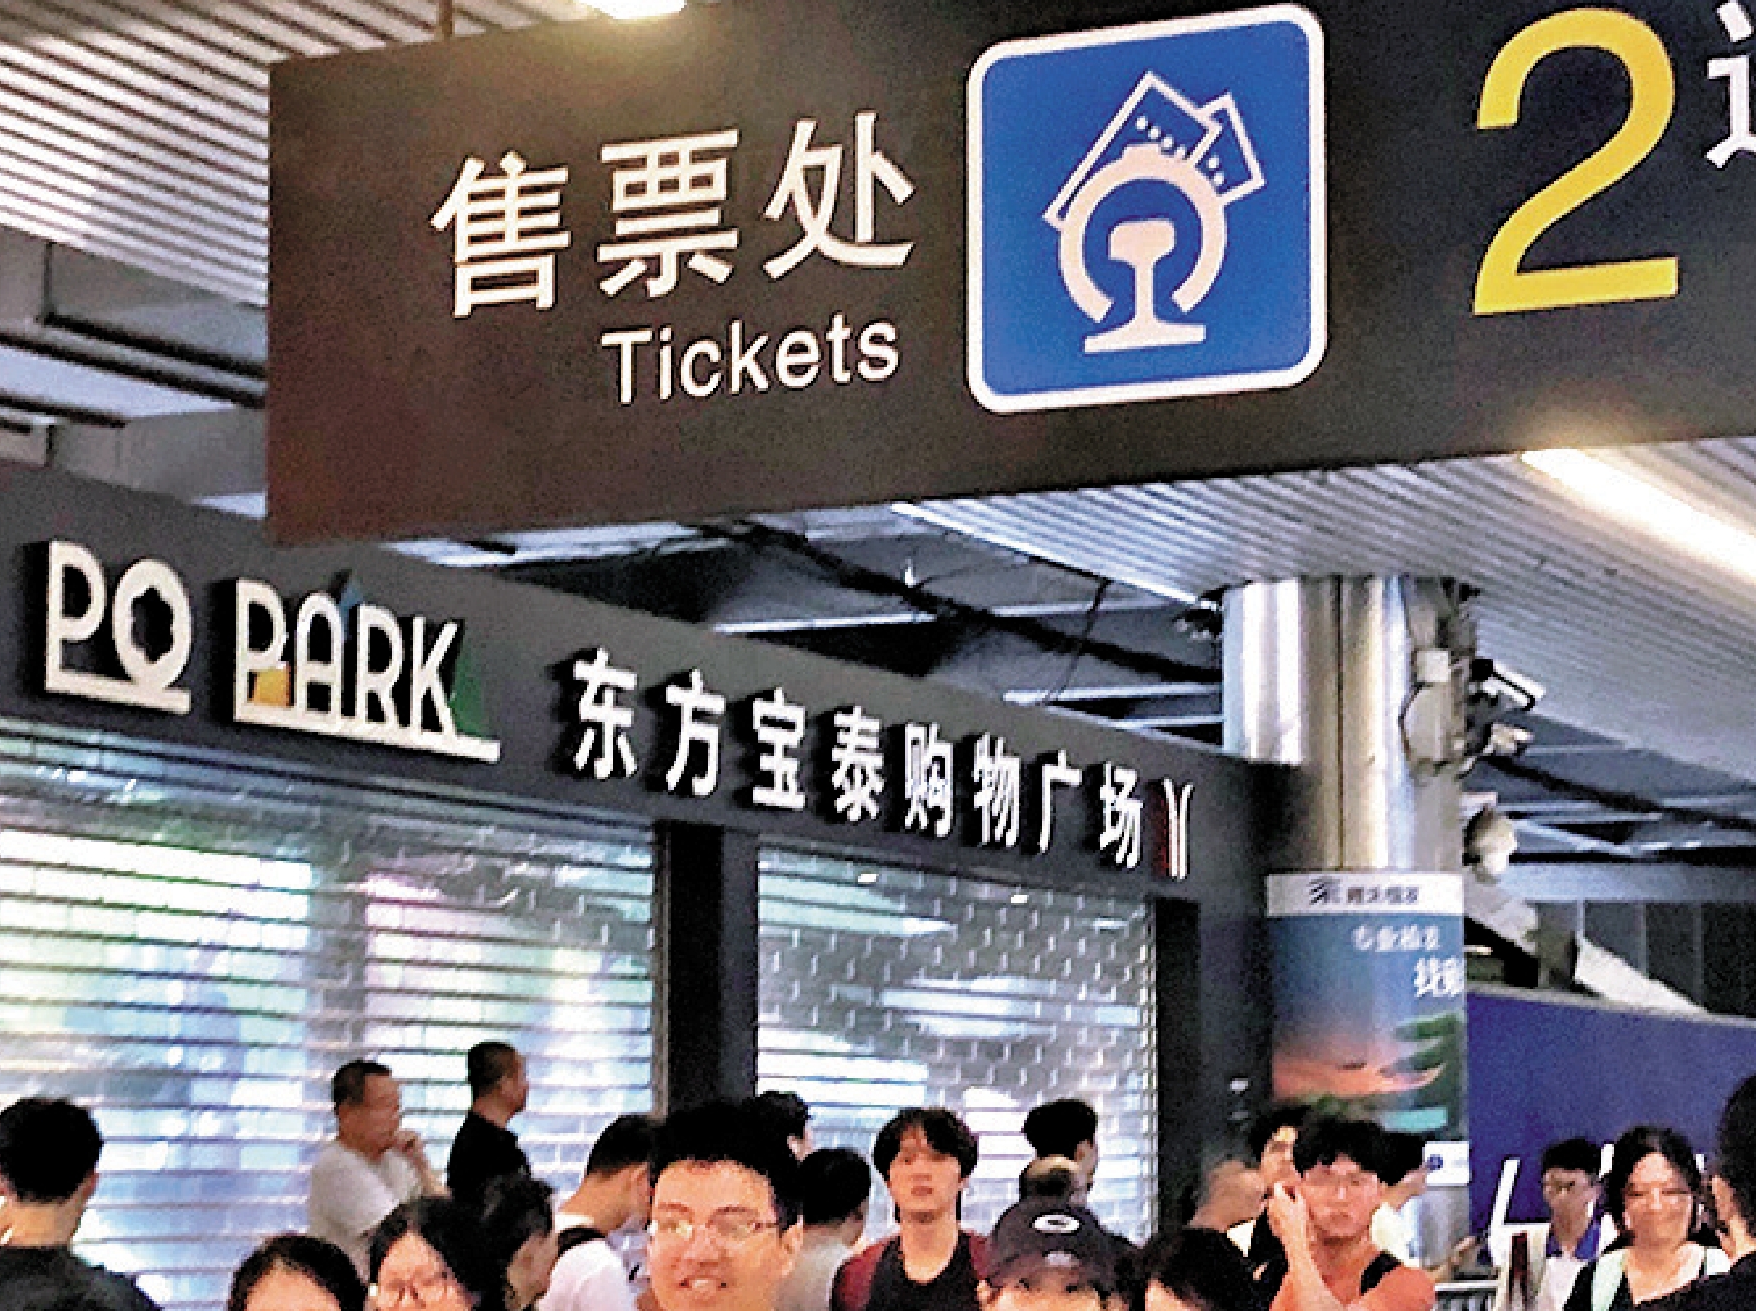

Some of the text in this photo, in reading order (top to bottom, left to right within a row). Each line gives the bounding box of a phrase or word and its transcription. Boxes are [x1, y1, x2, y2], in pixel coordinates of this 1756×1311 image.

[430, 109, 916, 318] 售票处
[1473, 6, 1678, 317] 2
[601, 311, 900, 406] Tickets
[234, 577, 501, 764] PARK
[567, 646, 1143, 868] 东方宝泰购物广场
